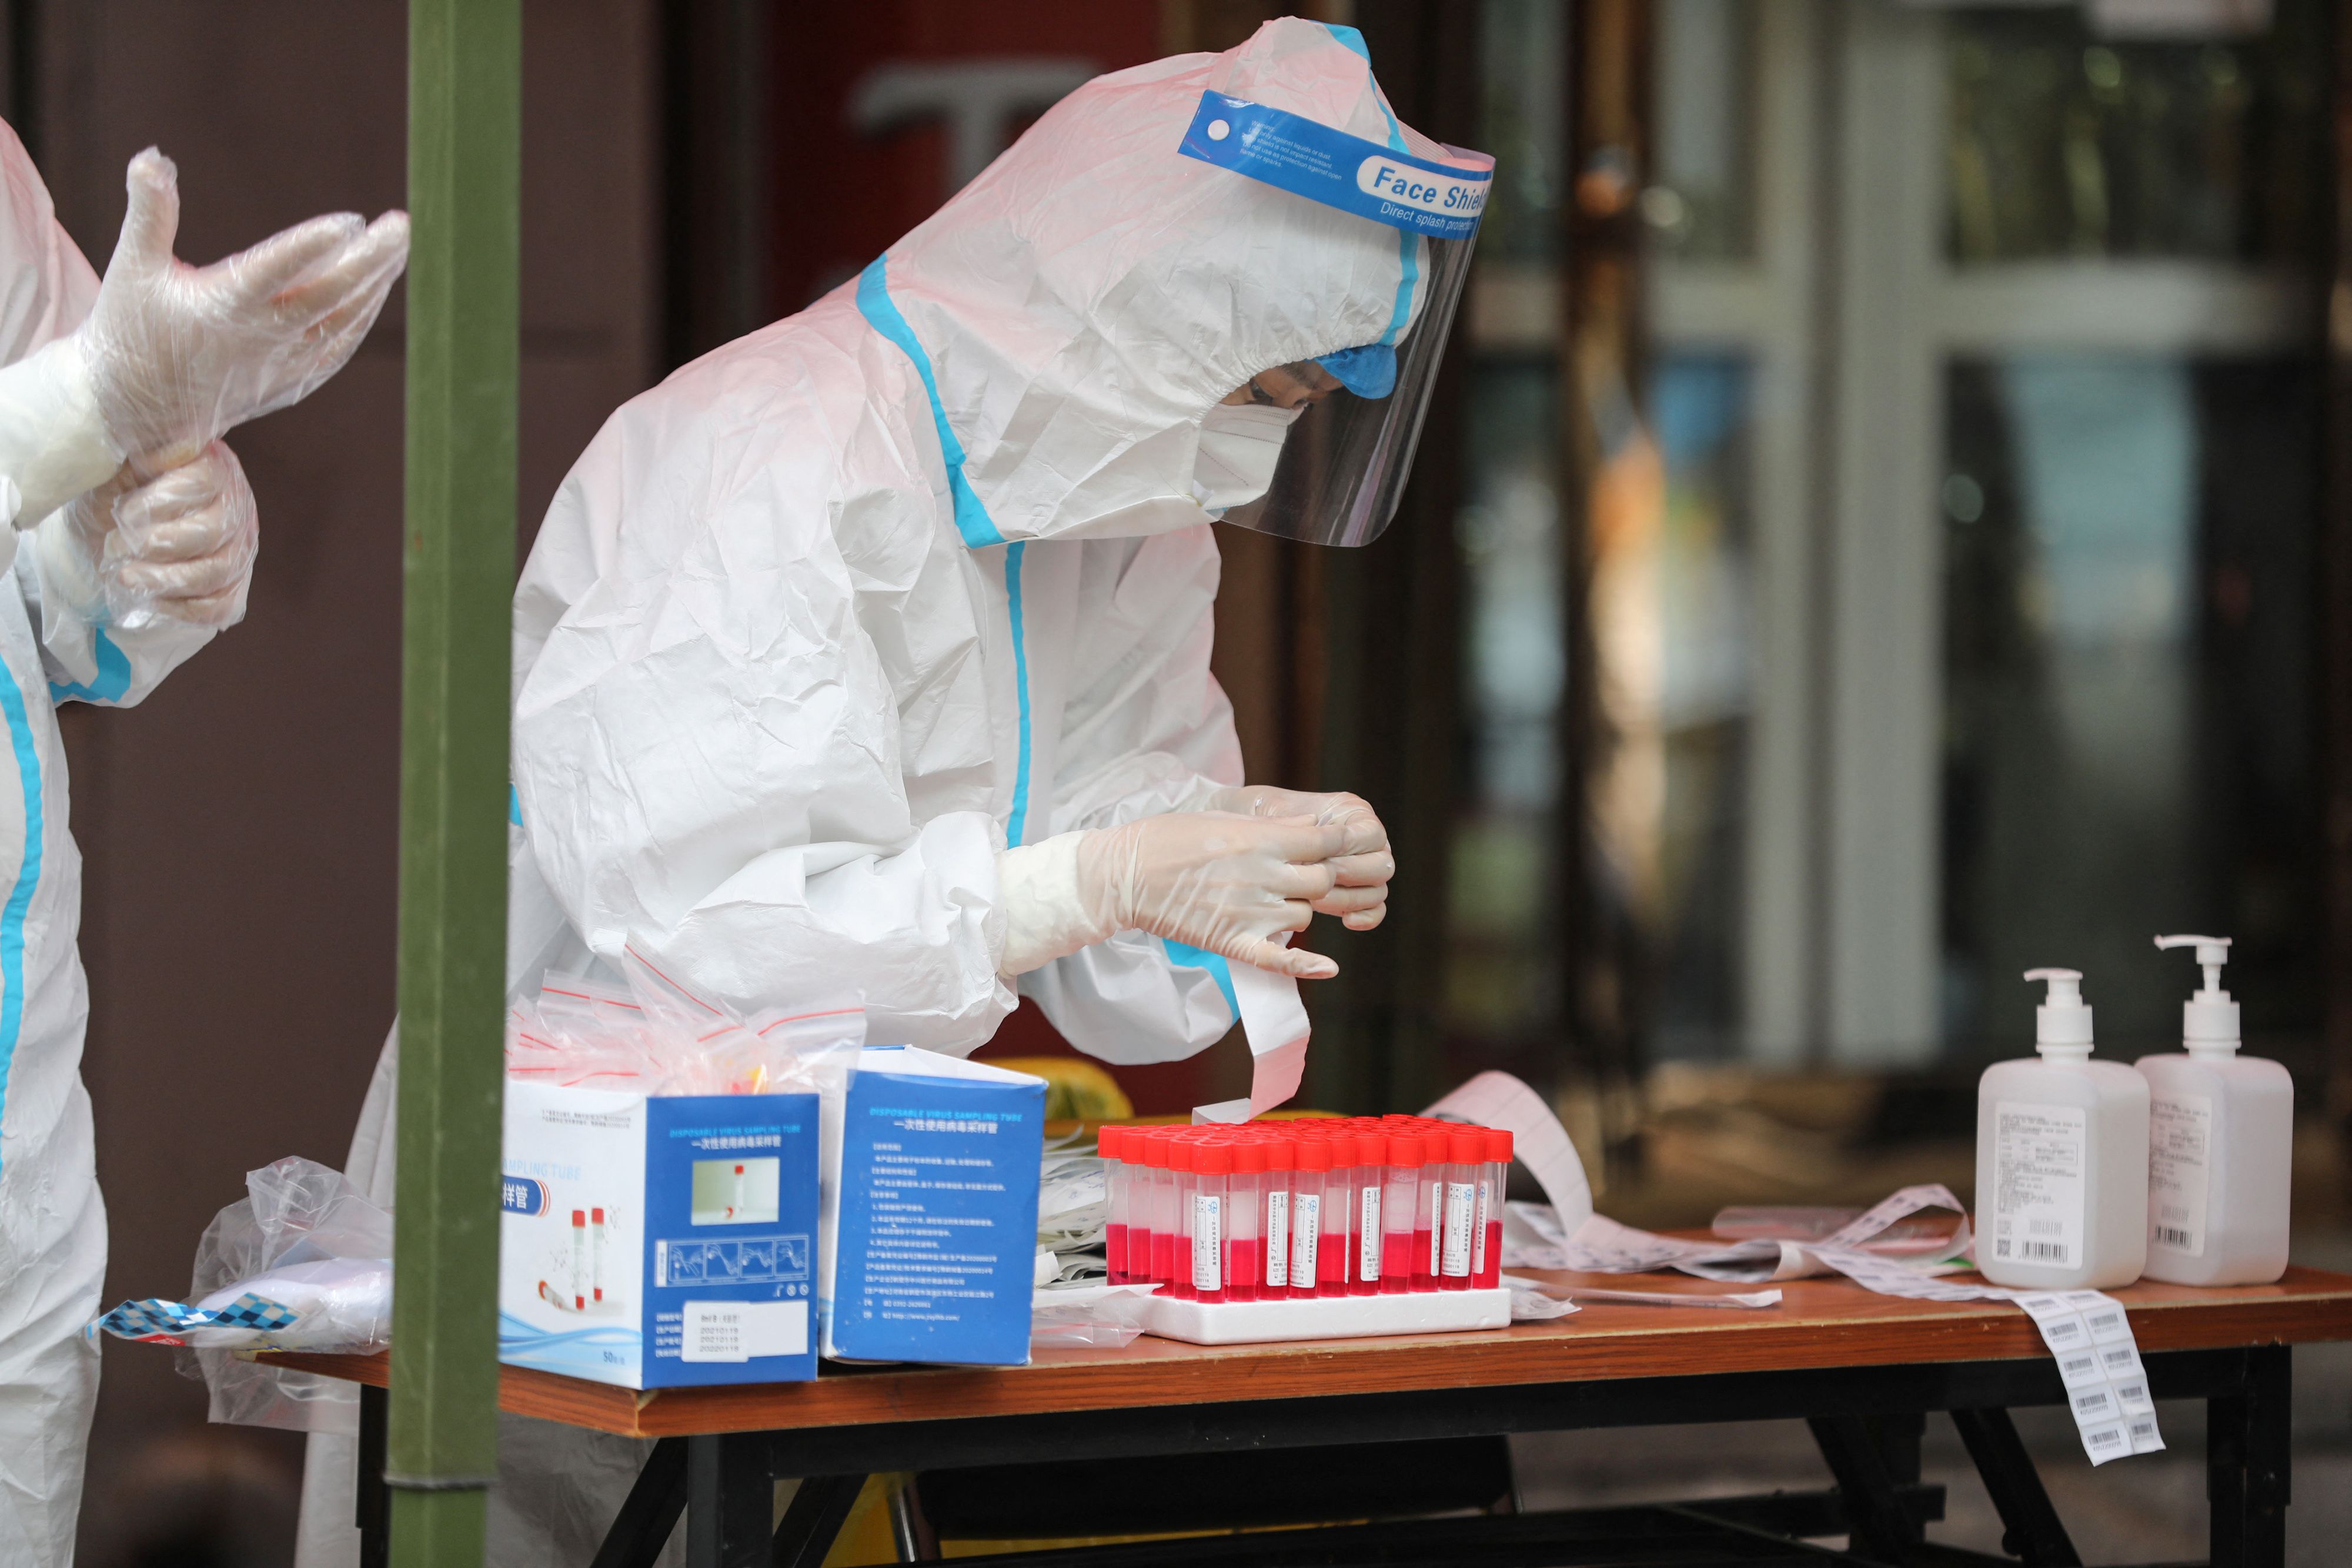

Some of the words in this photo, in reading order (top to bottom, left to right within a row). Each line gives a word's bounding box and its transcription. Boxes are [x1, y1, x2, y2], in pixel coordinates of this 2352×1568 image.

[1272, 134, 1294, 146] against
[1262, 146, 1272, 155] use
[1280, 154, 1308, 168] protection
[1308, 165, 1328, 175] against
[1328, 170, 1342, 180] open
[1290, 149, 1308, 161] impact
[1374, 166, 1436, 203] Face
[1380, 202, 1414, 220] Direct
[1415, 213, 1445, 228] splash
[870, 1107, 924, 1118] DISPOSABLE
[926, 1109, 953, 1119] VIRUS
[954, 1111, 998, 1121] SAMPLING
[1001, 1114, 1023, 1122] TUBE
[744, 1125, 781, 1135] SAMPLING
[894, 1118, 998, 1134] 一次性使用病毒采样管
[552, 1164, 582, 1181] TUBE
